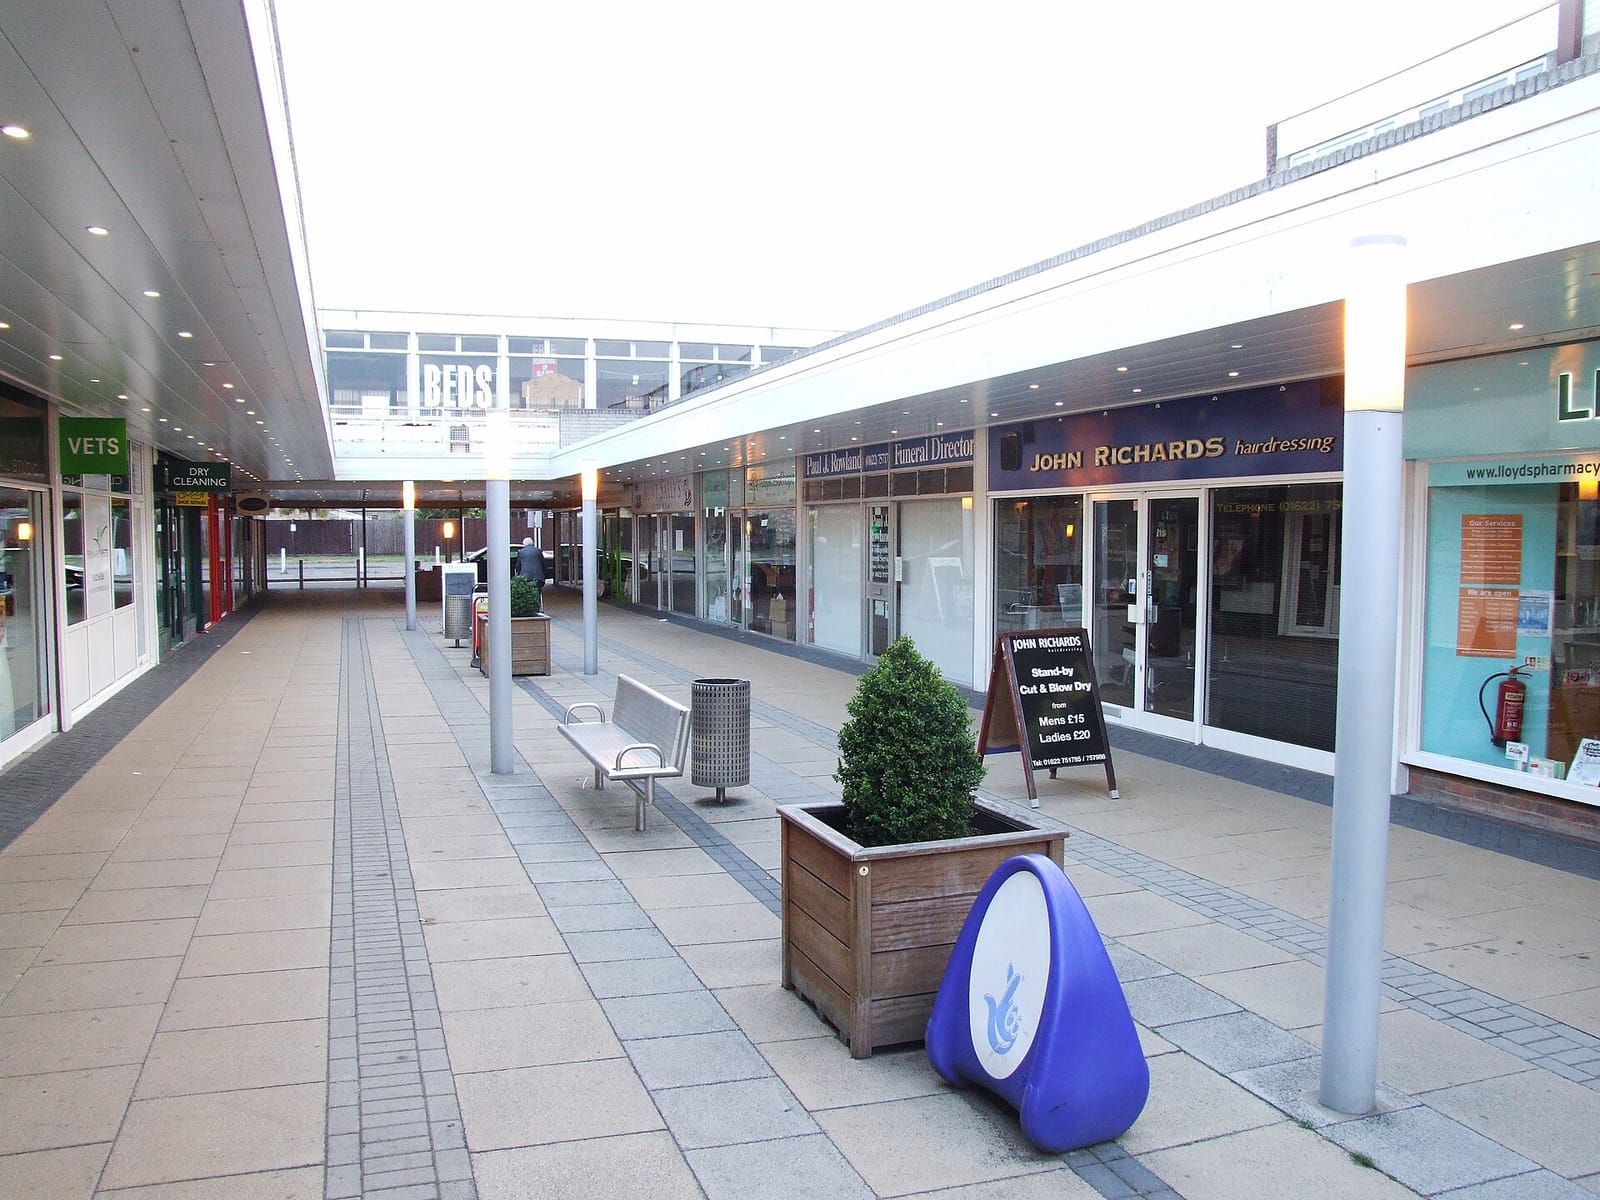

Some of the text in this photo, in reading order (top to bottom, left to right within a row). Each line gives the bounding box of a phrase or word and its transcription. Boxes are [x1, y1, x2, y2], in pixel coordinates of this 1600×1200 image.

[423, 363, 493, 409] BEDS
[1557, 367, 1600, 422] L
[67, 437, 120, 456] VETS
[894, 439, 928, 465] Funeral
[1030, 435, 1336, 473] JOHN RICHARDS hairdressing
[806, 456, 822, 475] Paul
[831, 449, 862, 472] Rowland
[189, 467, 210, 477] DRY
[173, 476, 227, 487] CLEANING
[1216, 503, 1276, 513] TELEPHONE
[1279, 501, 1320, 512] (01622)
[1484, 519, 1516, 527] Services
[1480, 589, 1492, 597] are
[1493, 590, 1512, 598] open
[1013, 636, 1082, 652] JOHN RICHARDS
[1031, 666, 1074, 678] Stand-by
[1020, 681, 1092, 695] Cut & Blow Dry
[1038, 713, 1085, 727] Mens £15
[1038, 729, 1091, 744] Ladies £20
